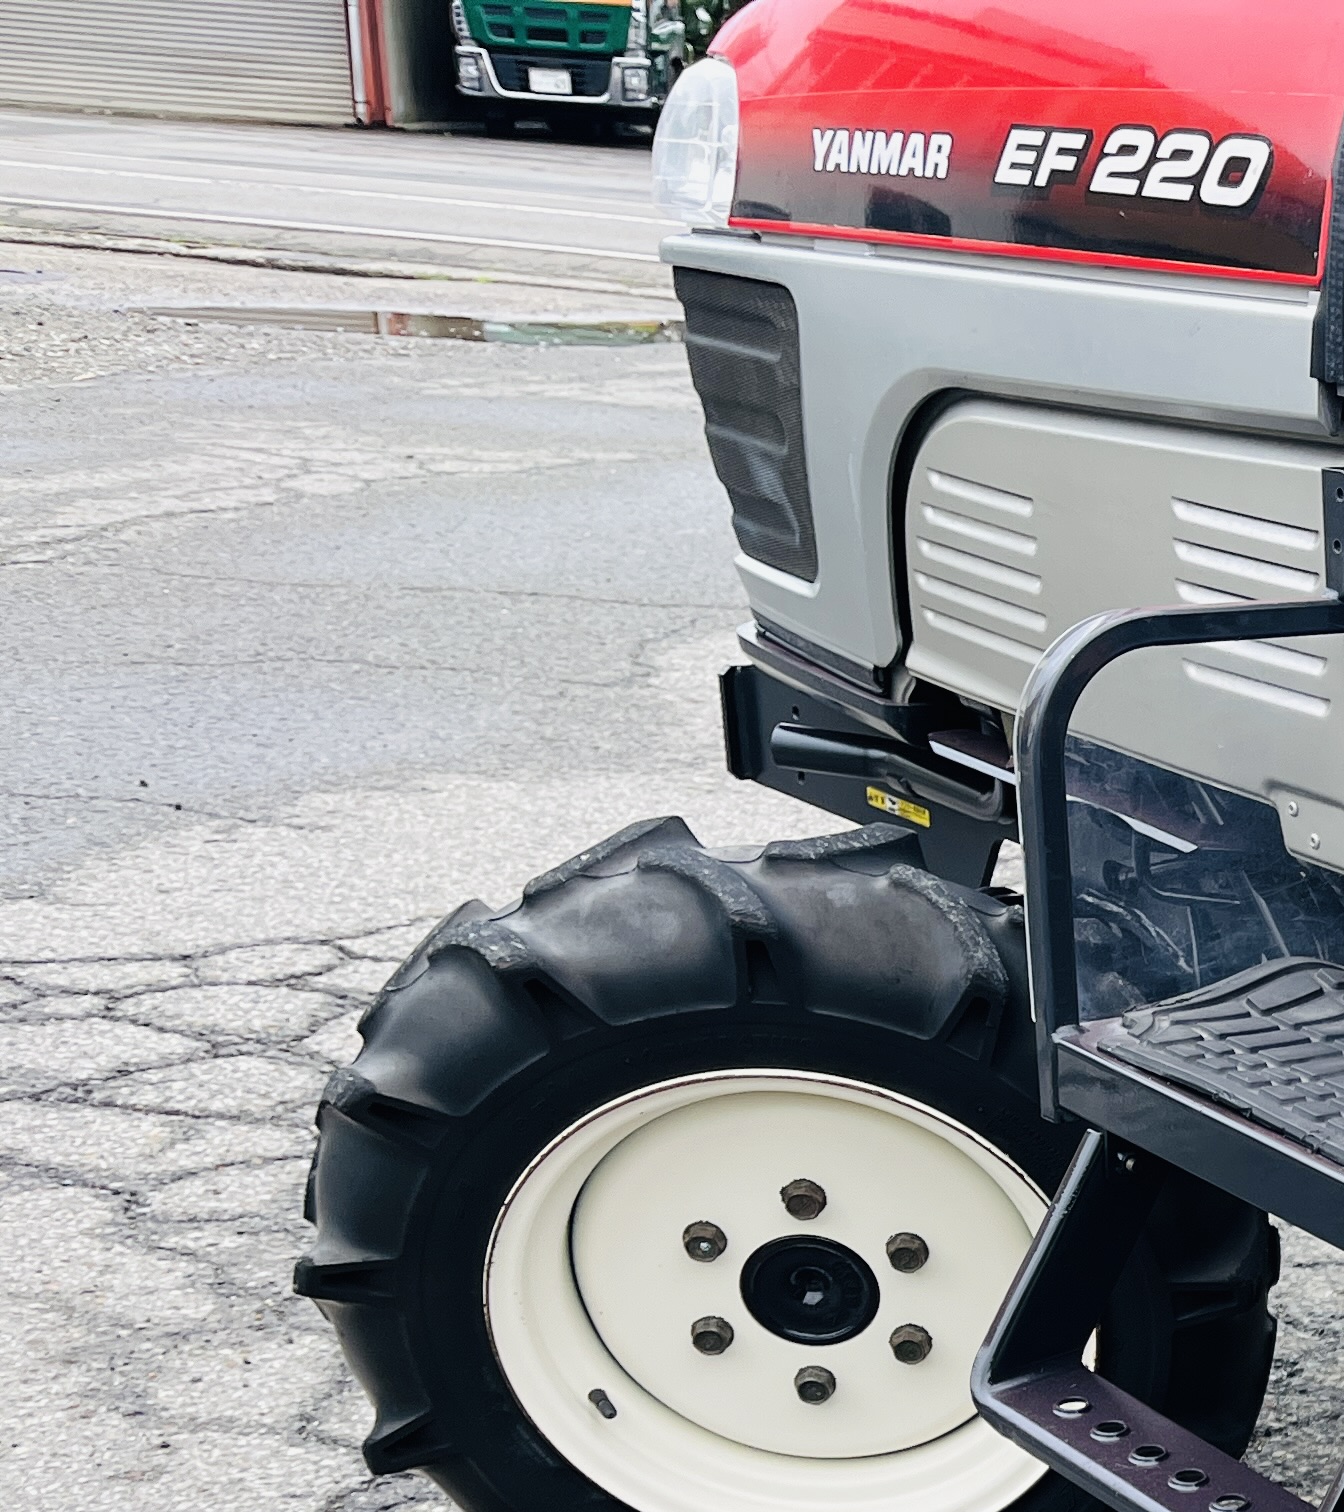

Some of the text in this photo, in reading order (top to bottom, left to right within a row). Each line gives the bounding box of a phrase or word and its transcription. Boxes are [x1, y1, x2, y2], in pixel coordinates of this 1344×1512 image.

[811, 127, 952, 180] YANMAR
[992, 126, 1273, 210] EF 220
